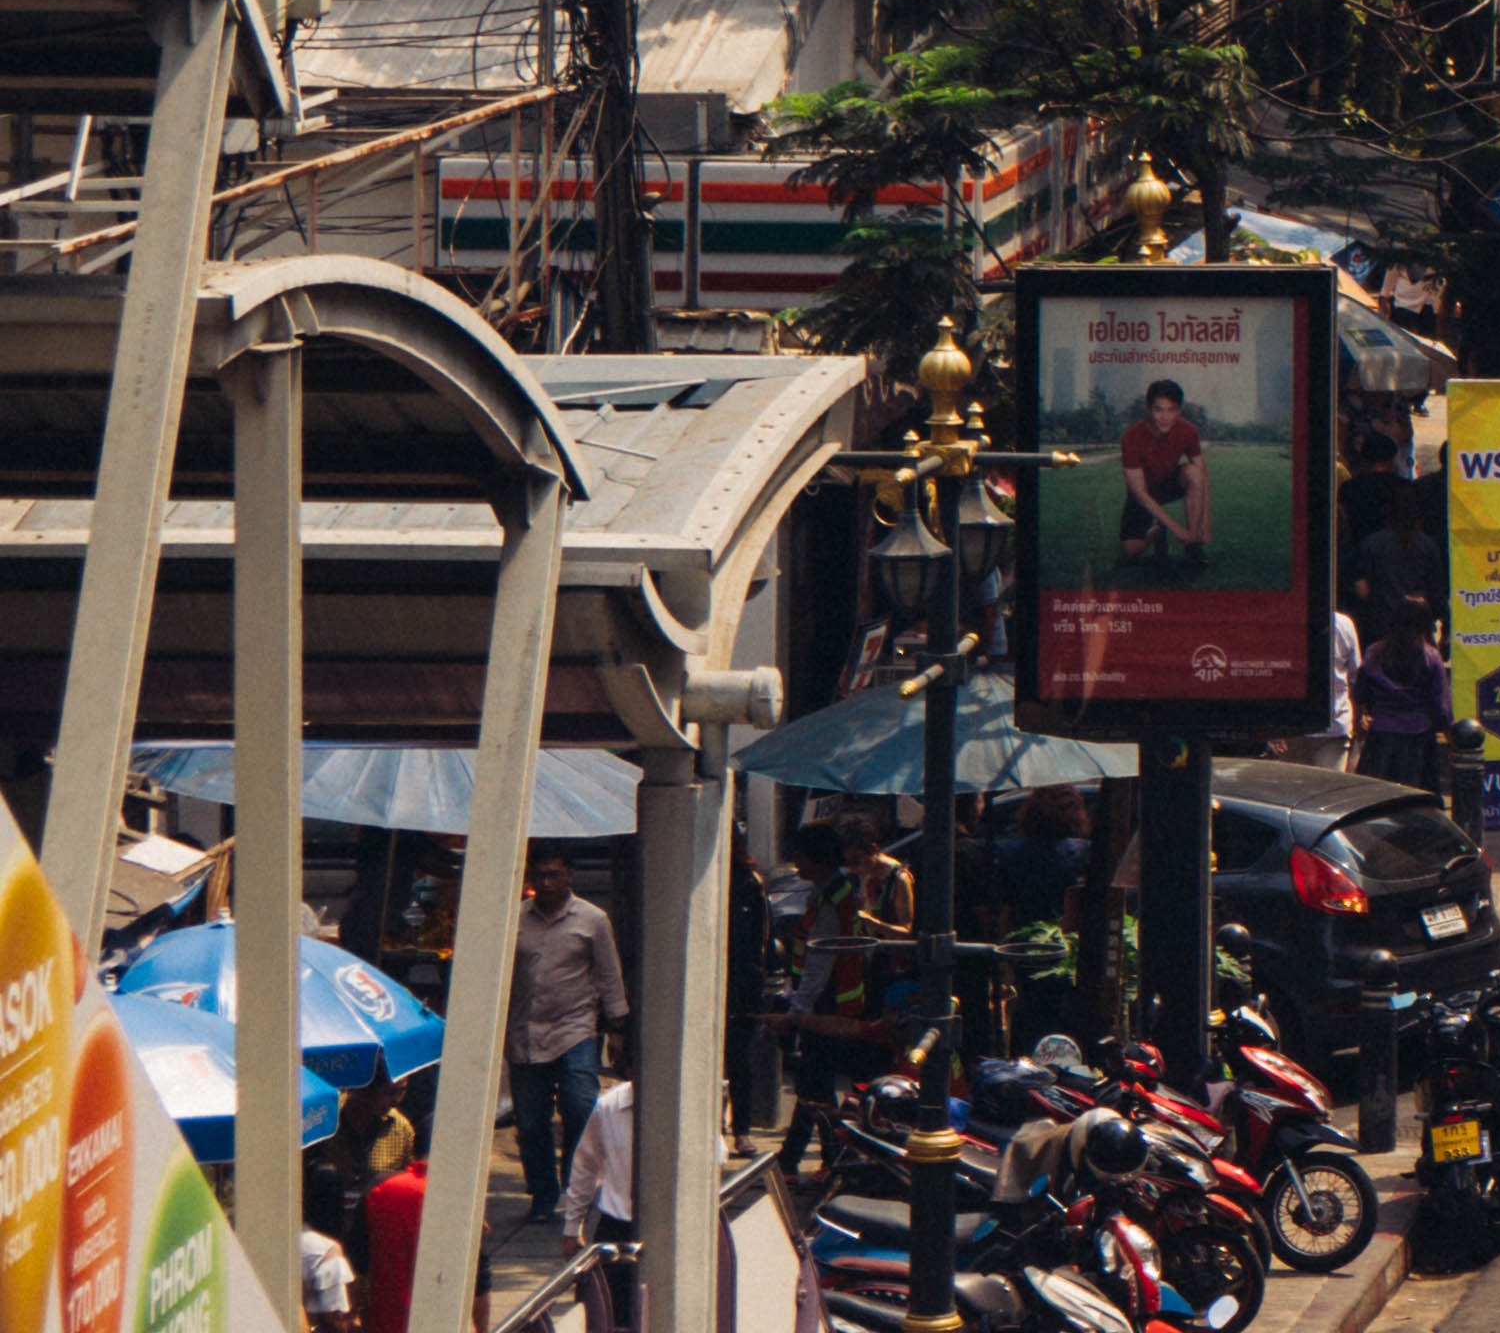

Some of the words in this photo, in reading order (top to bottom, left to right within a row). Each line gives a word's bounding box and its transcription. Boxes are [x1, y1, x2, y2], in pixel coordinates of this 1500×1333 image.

[1088, 311, 1151, 342] เอไอเอ
[1157, 307, 1244, 343] ไวทัลลิตี้
[1088, 348, 1241, 368] ประกันสำหรับคนรักสุขภาพ
[67, 1110, 124, 1187] EKKAMAI
[150, 1221, 214, 1322] PHROM
